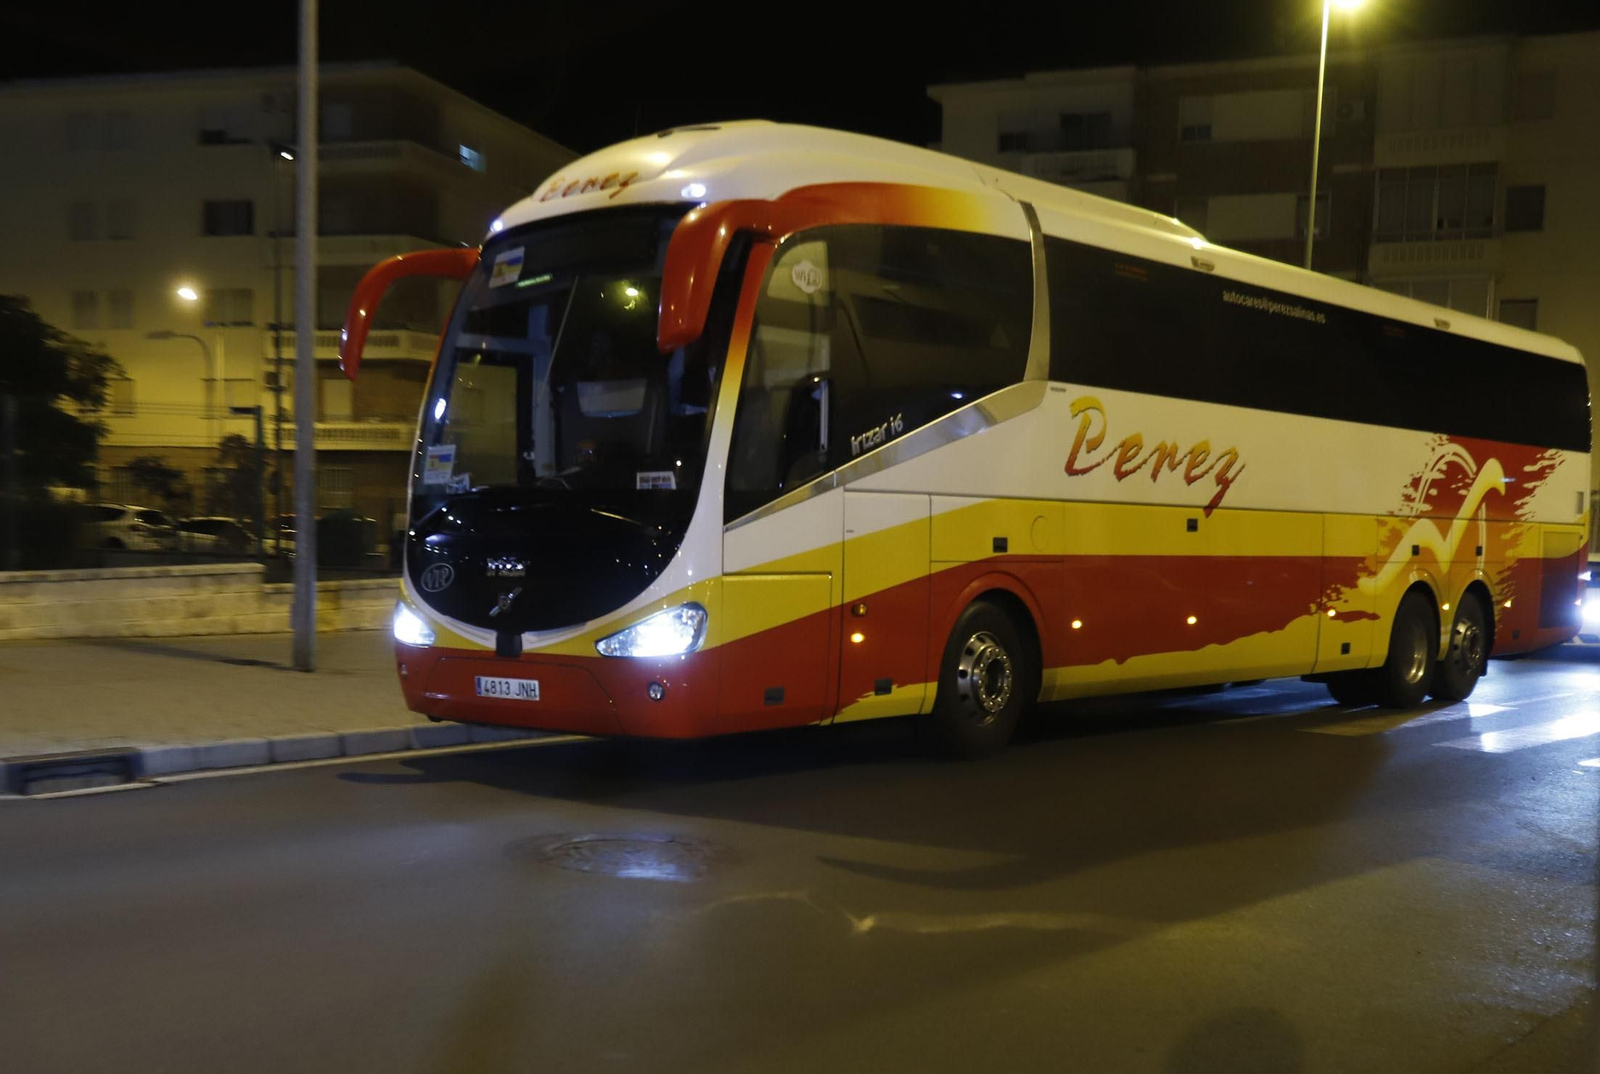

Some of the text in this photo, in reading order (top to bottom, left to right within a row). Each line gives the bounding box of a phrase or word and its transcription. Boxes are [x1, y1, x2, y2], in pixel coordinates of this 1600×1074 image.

[1064, 395, 1247, 519] Perez
[484, 680, 538, 698] 4813 JNH
